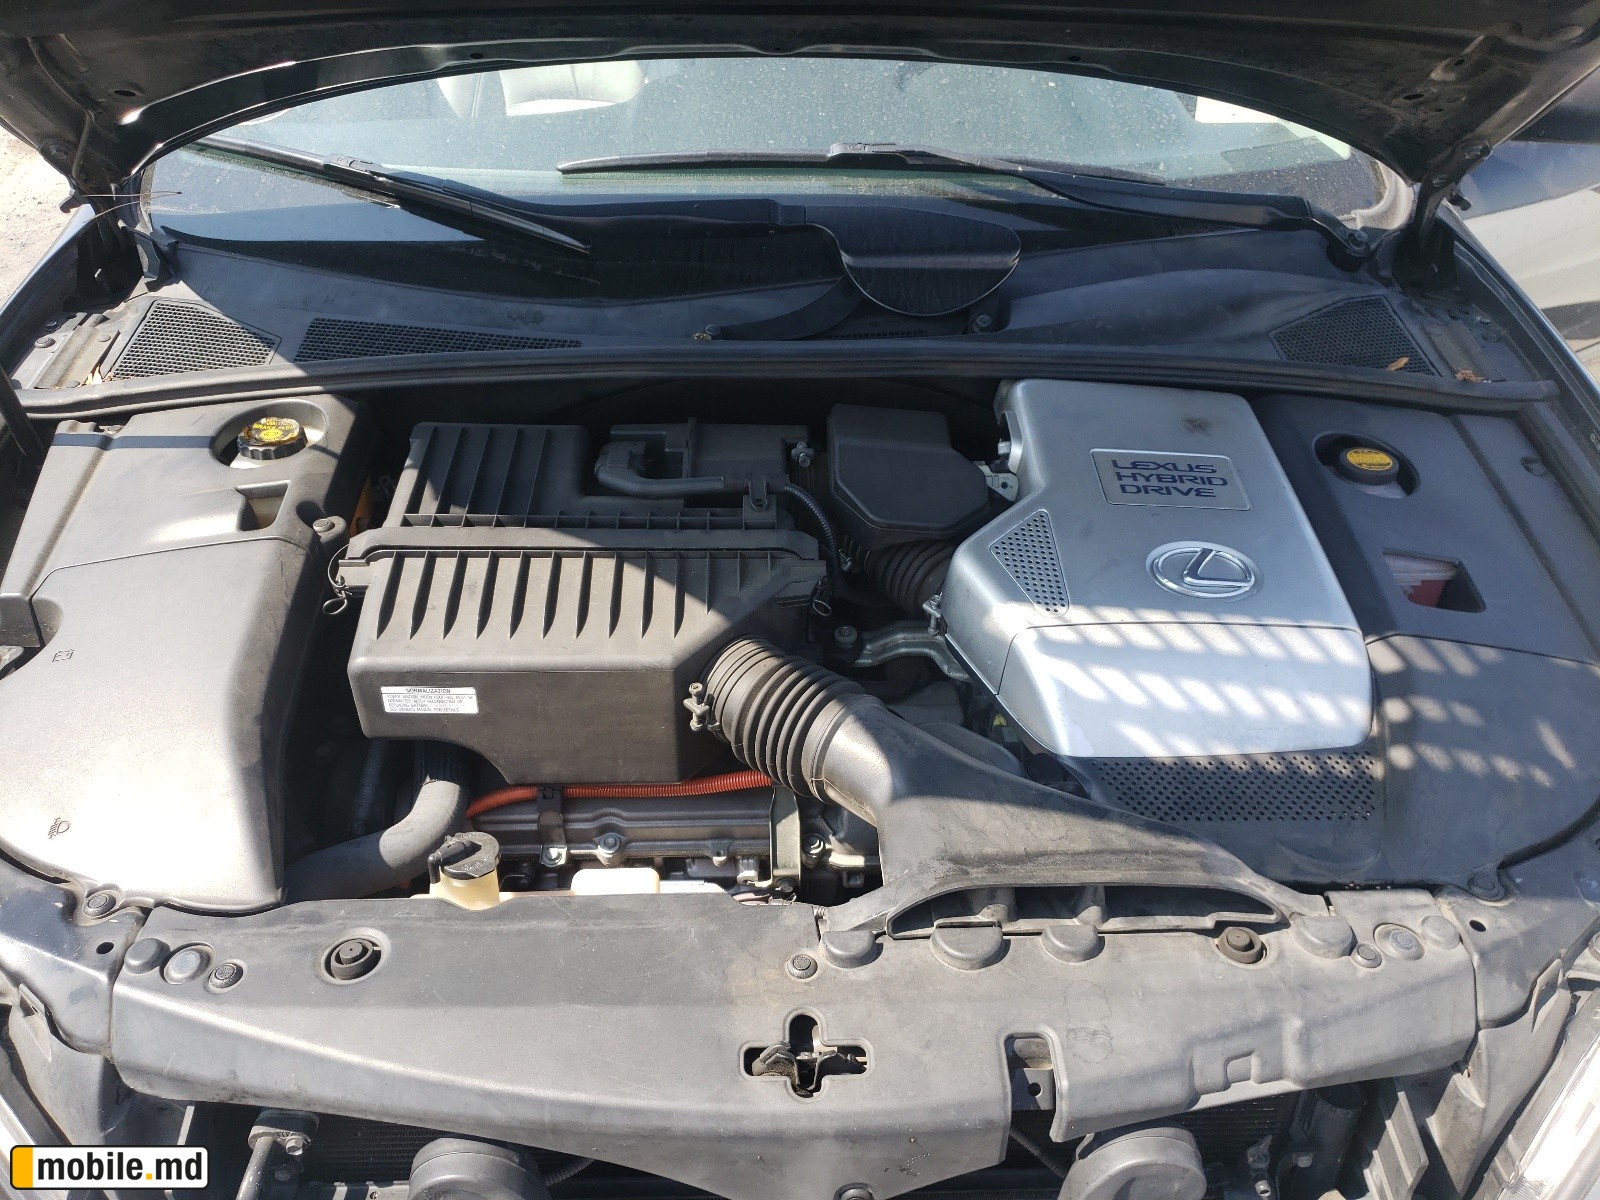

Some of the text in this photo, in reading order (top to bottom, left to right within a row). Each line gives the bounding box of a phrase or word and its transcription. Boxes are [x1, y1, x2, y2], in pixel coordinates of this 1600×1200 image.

[1111, 459, 1217, 474] LEXUS
[1115, 471, 1228, 487] HYBRID
[1119, 484, 1217, 498] DRIVE
